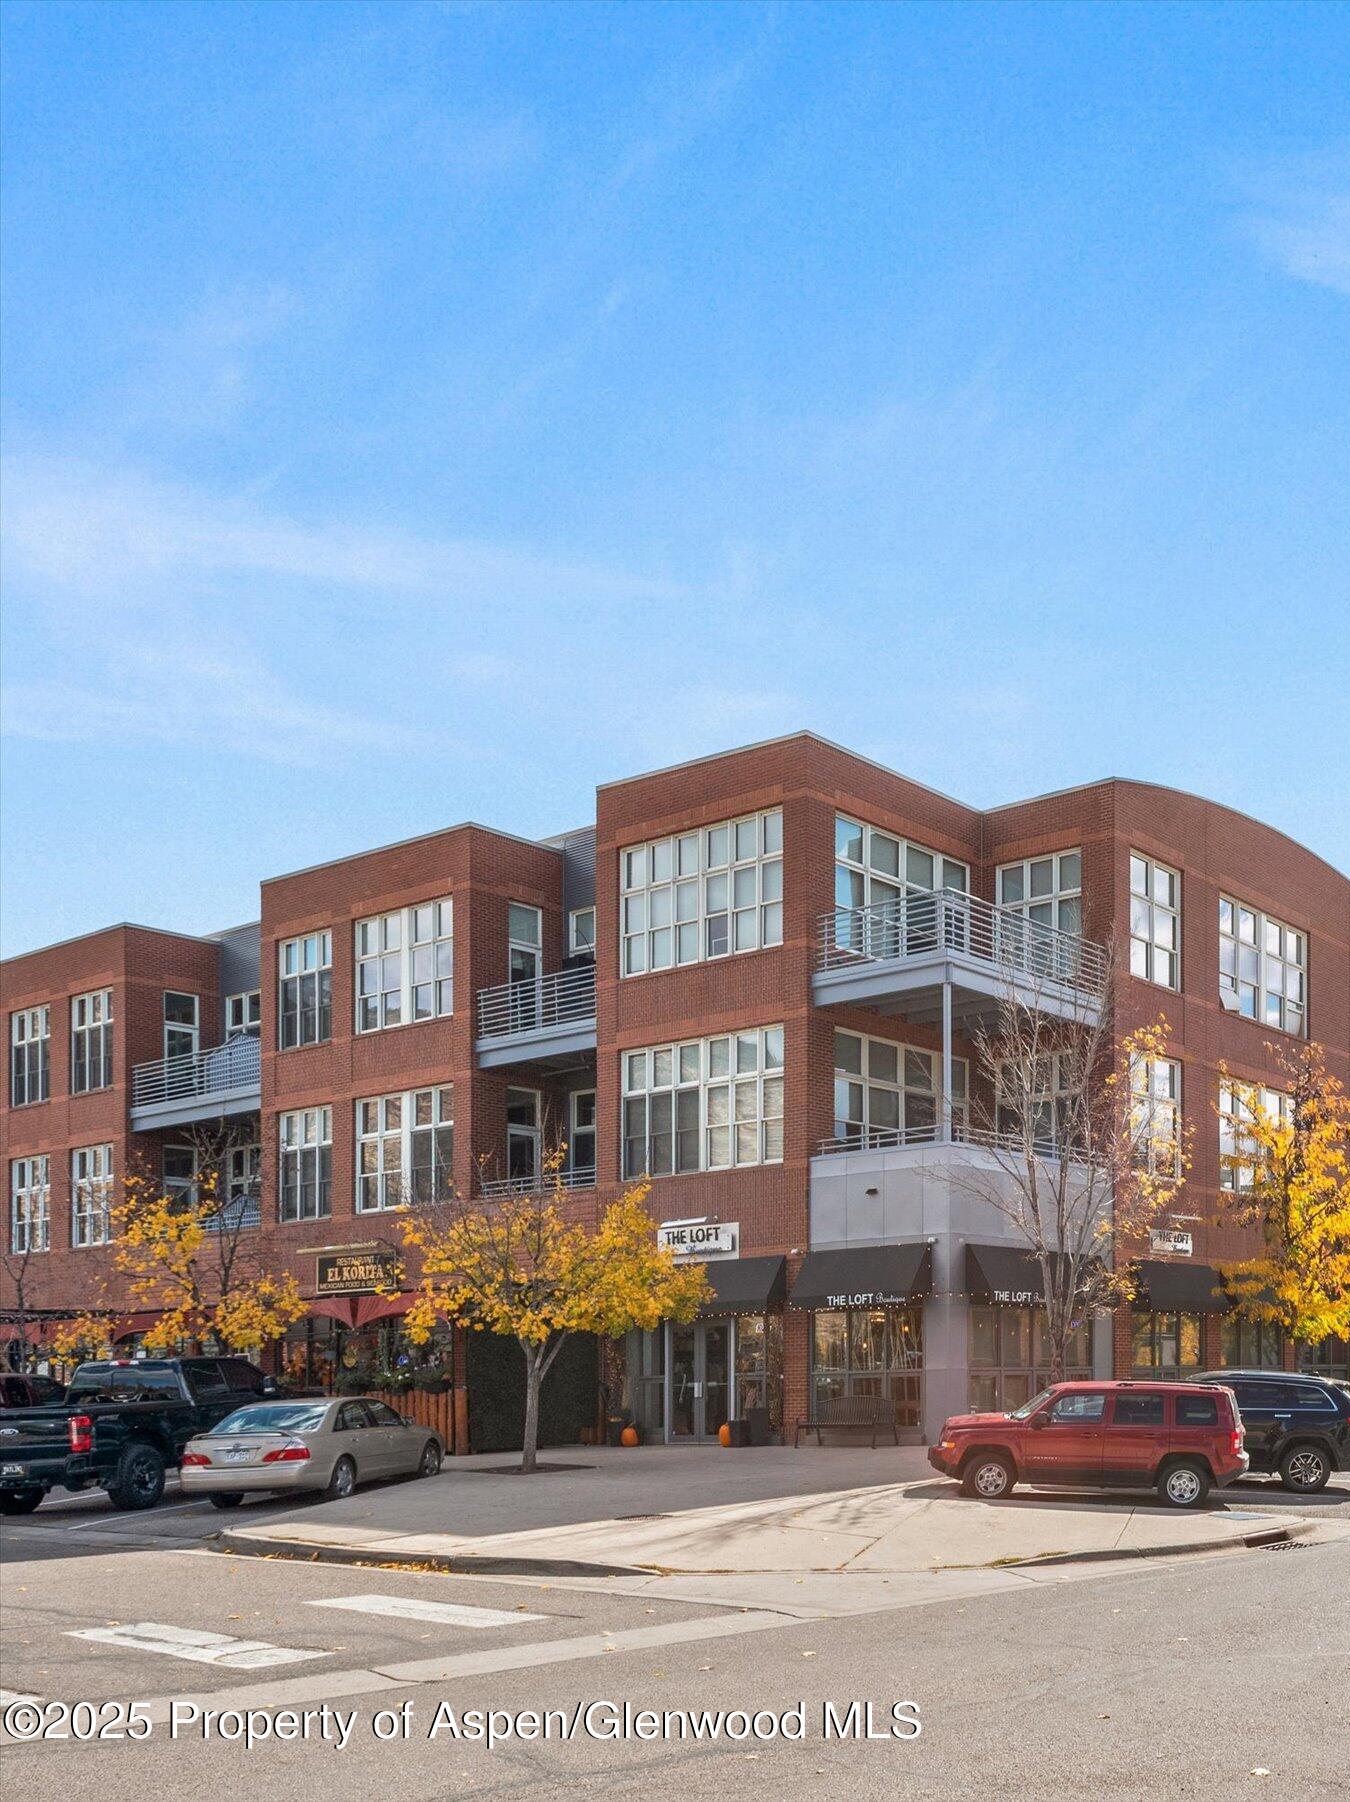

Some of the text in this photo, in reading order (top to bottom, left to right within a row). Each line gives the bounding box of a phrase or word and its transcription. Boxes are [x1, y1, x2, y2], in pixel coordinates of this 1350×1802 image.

[665, 1227, 720, 1245] THE LOFT
[1159, 1231, 1189, 1244] THE LOFT
[327, 1267, 341, 1282] EL
[320, 1281, 345, 1289] MEXICAN
[345, 1280, 360, 1288] FOOD
[827, 1292, 906, 1306] THE LOFT Boutique
[994, 1290, 1010, 1302] THE
[1011, 1291, 1032, 1303] LOFT
